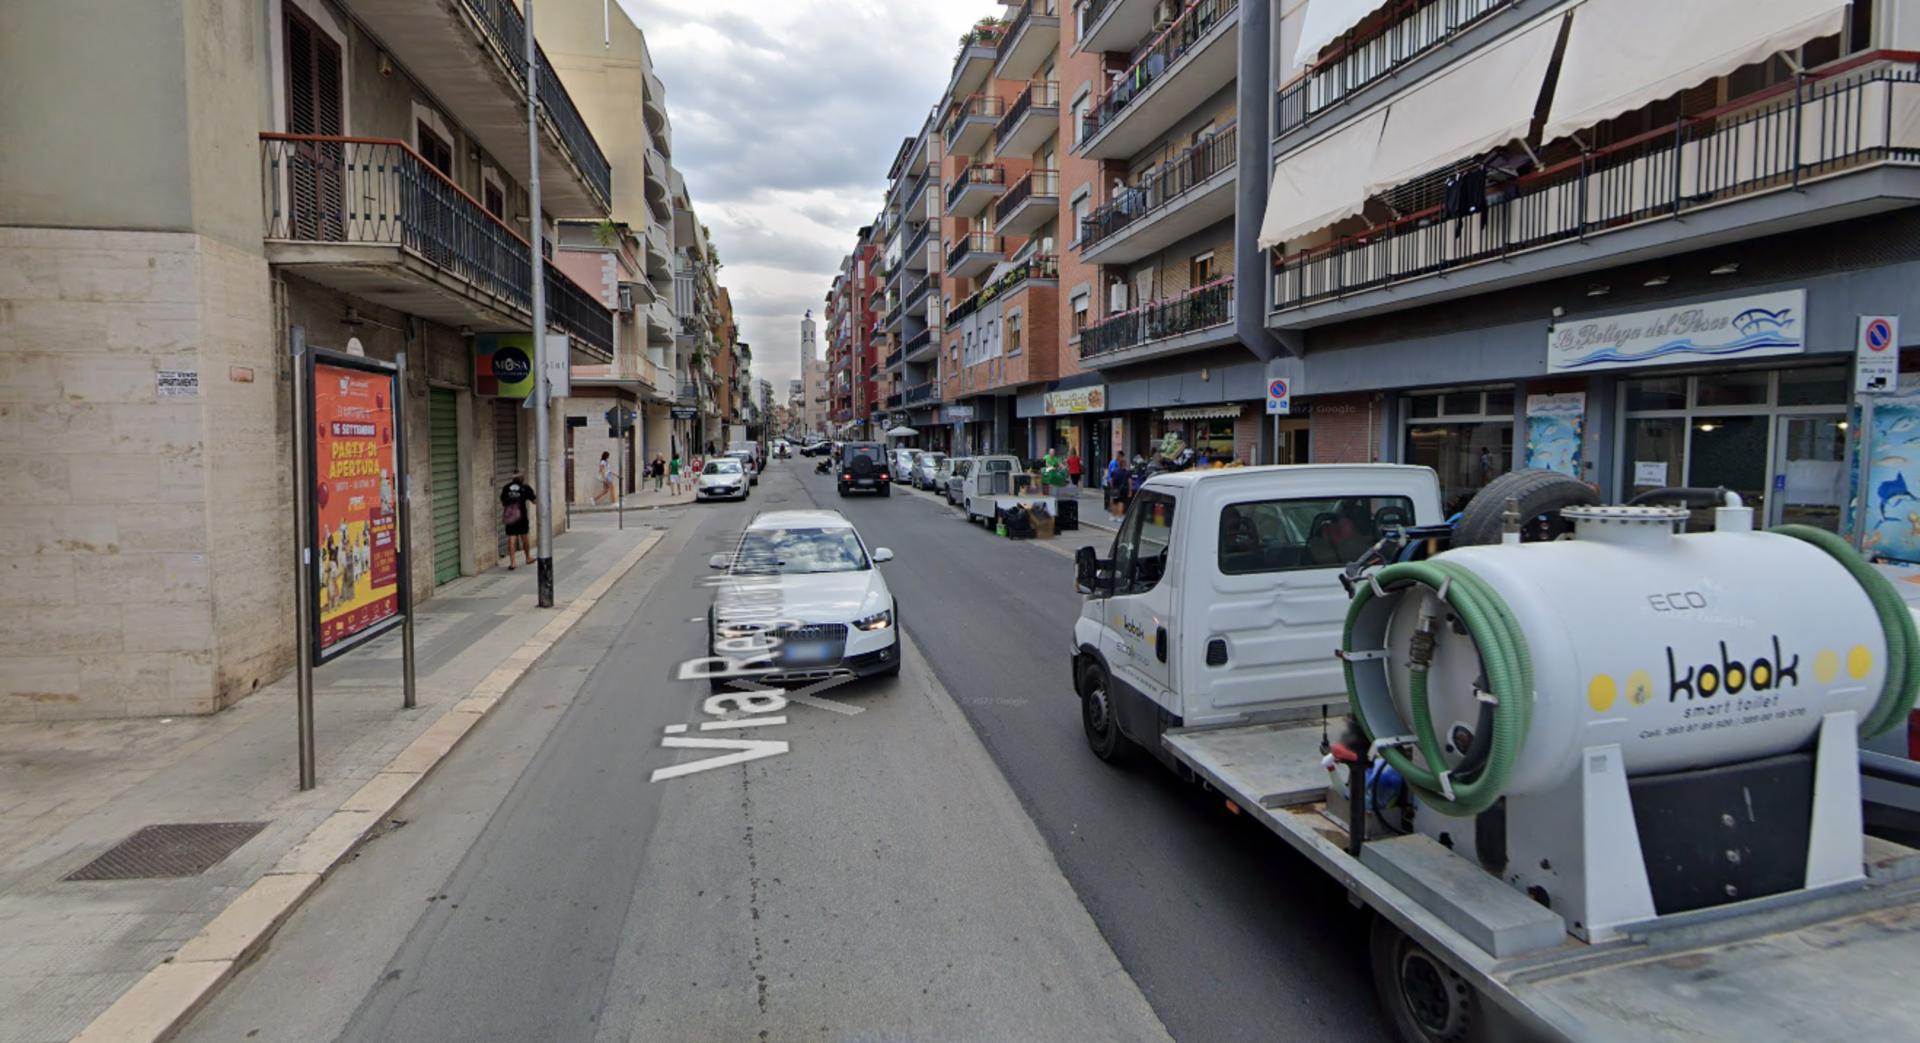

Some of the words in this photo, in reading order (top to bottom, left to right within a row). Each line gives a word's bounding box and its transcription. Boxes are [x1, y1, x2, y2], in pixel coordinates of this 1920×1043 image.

[1576, 322, 1641, 348] Bottega
[1643, 314, 1675, 338] del
[1673, 309, 1729, 335] Pesce
[342, 424, 376, 436] SETTEMBRE
[331, 441, 365, 459] PARTY
[329, 459, 381, 480] APERTURA
[1648, 591, 1708, 612] ECO
[1666, 634, 1799, 703] kobak
[1684, 700, 1729, 719] smart
[1736, 693, 1780, 713] toilet
